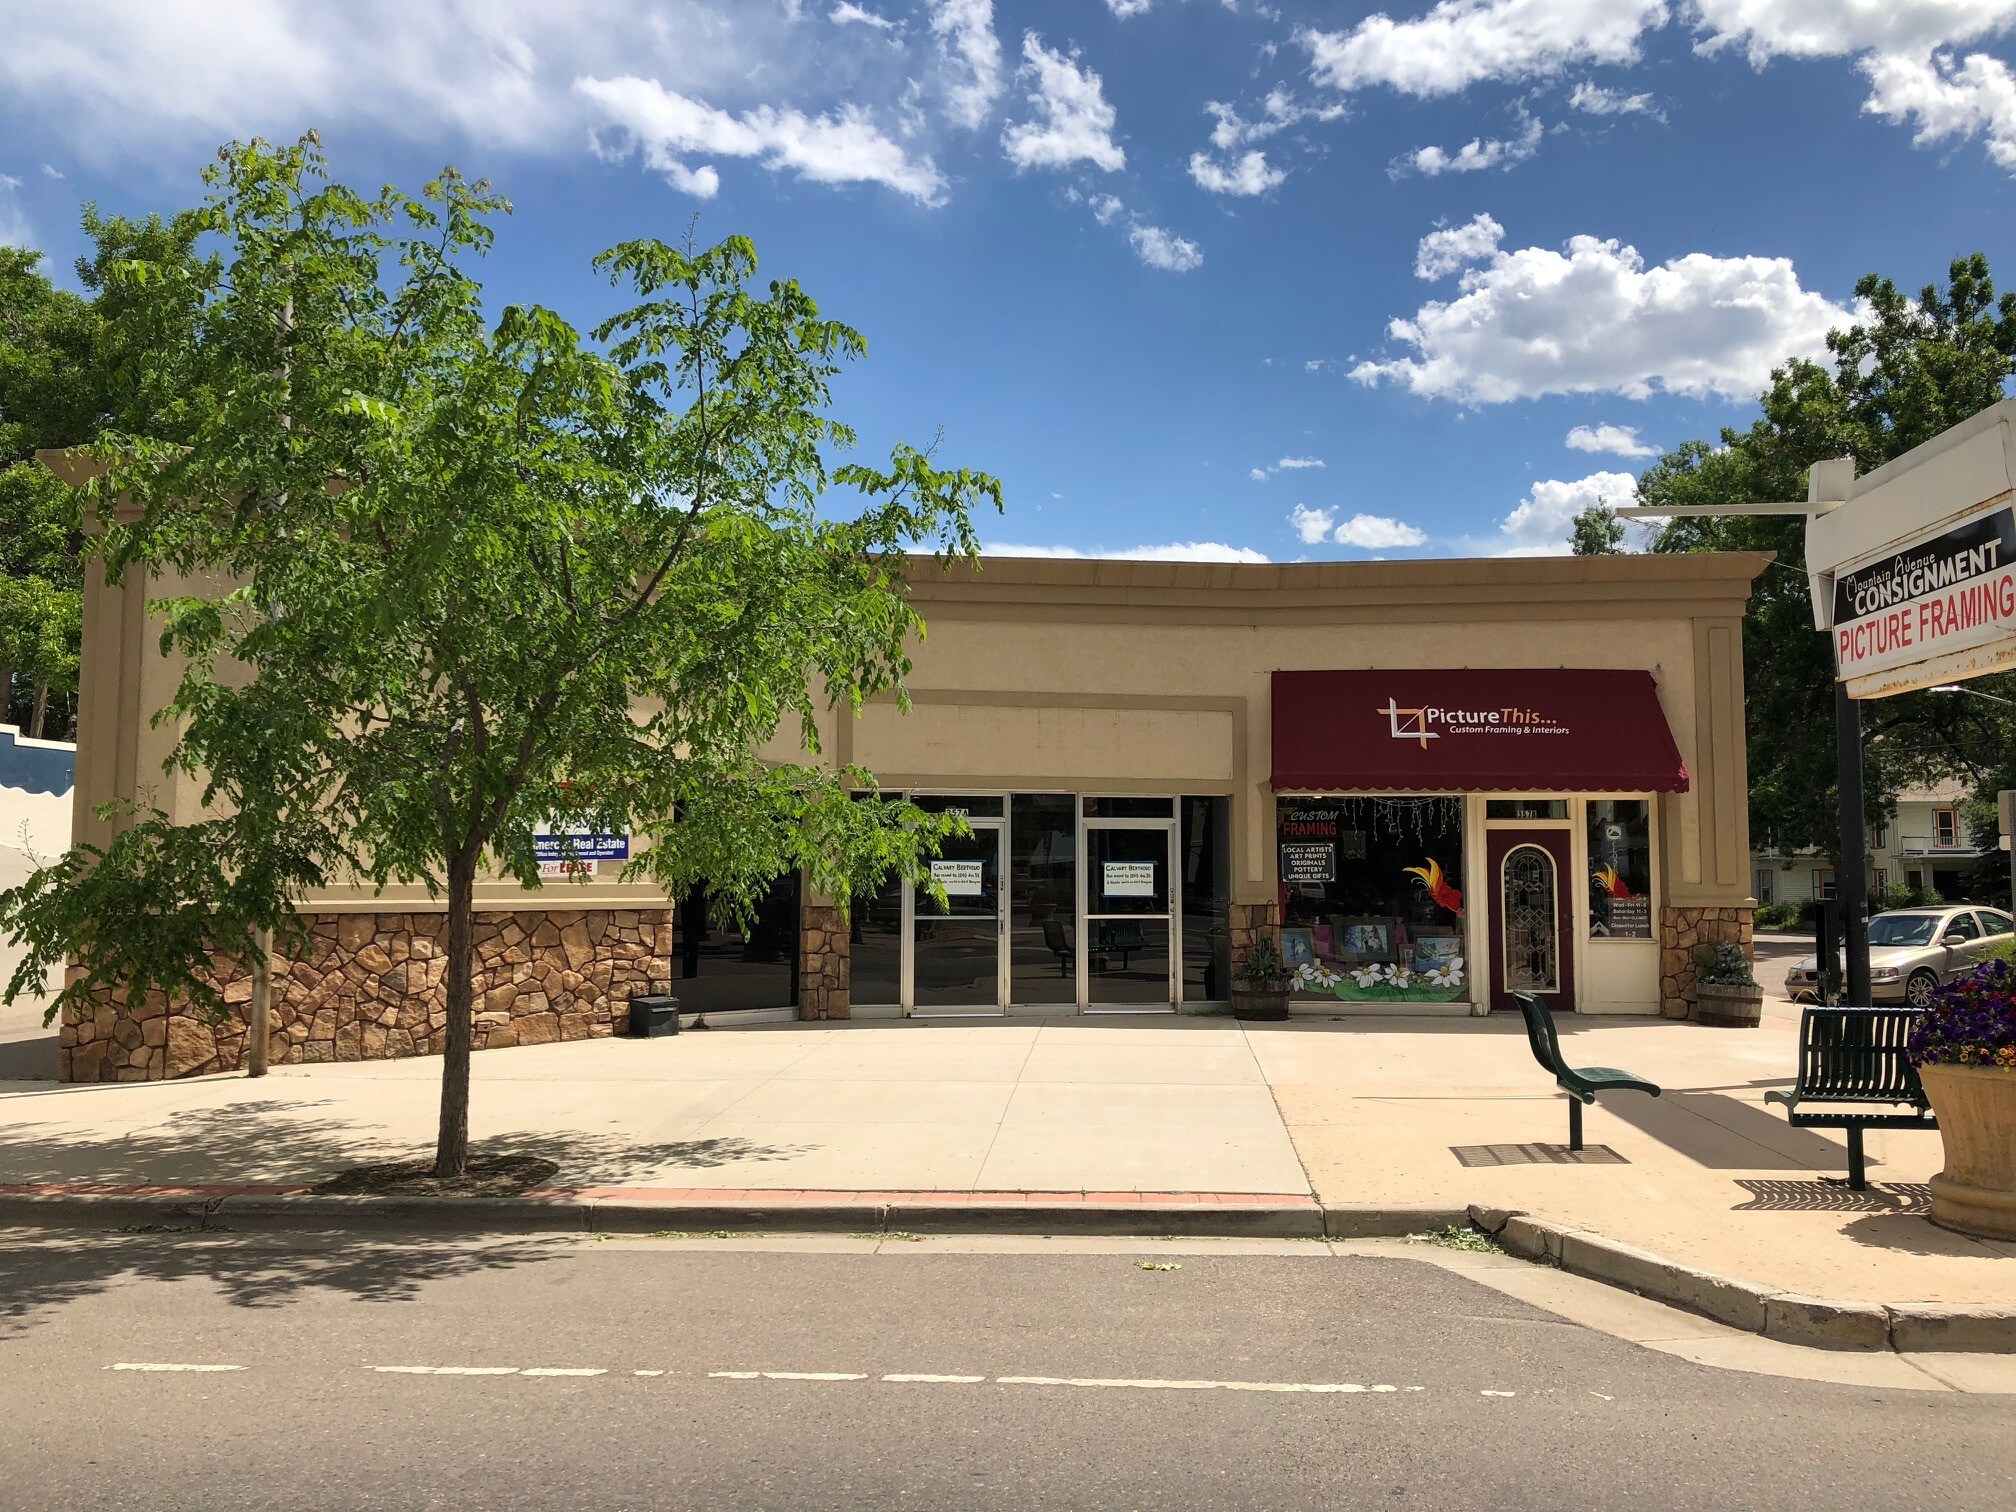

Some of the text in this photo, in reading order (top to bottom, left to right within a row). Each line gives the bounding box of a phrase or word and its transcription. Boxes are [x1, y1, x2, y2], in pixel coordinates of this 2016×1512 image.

[1846, 553, 1935, 602] Mountain Avenue
[1855, 538, 2002, 615] CONSIGNMENT
[1840, 575, 2015, 665] PICTURE FRAMING
[1449, 725, 1570, 735] Custom Framing & Interiors
[1291, 810, 1339, 821] CUSTOM
[1283, 822, 1337, 836] FRAMING
[573, 838, 594, 849] Real
[597, 837, 626, 849] Estate
[542, 864, 559, 873] For
